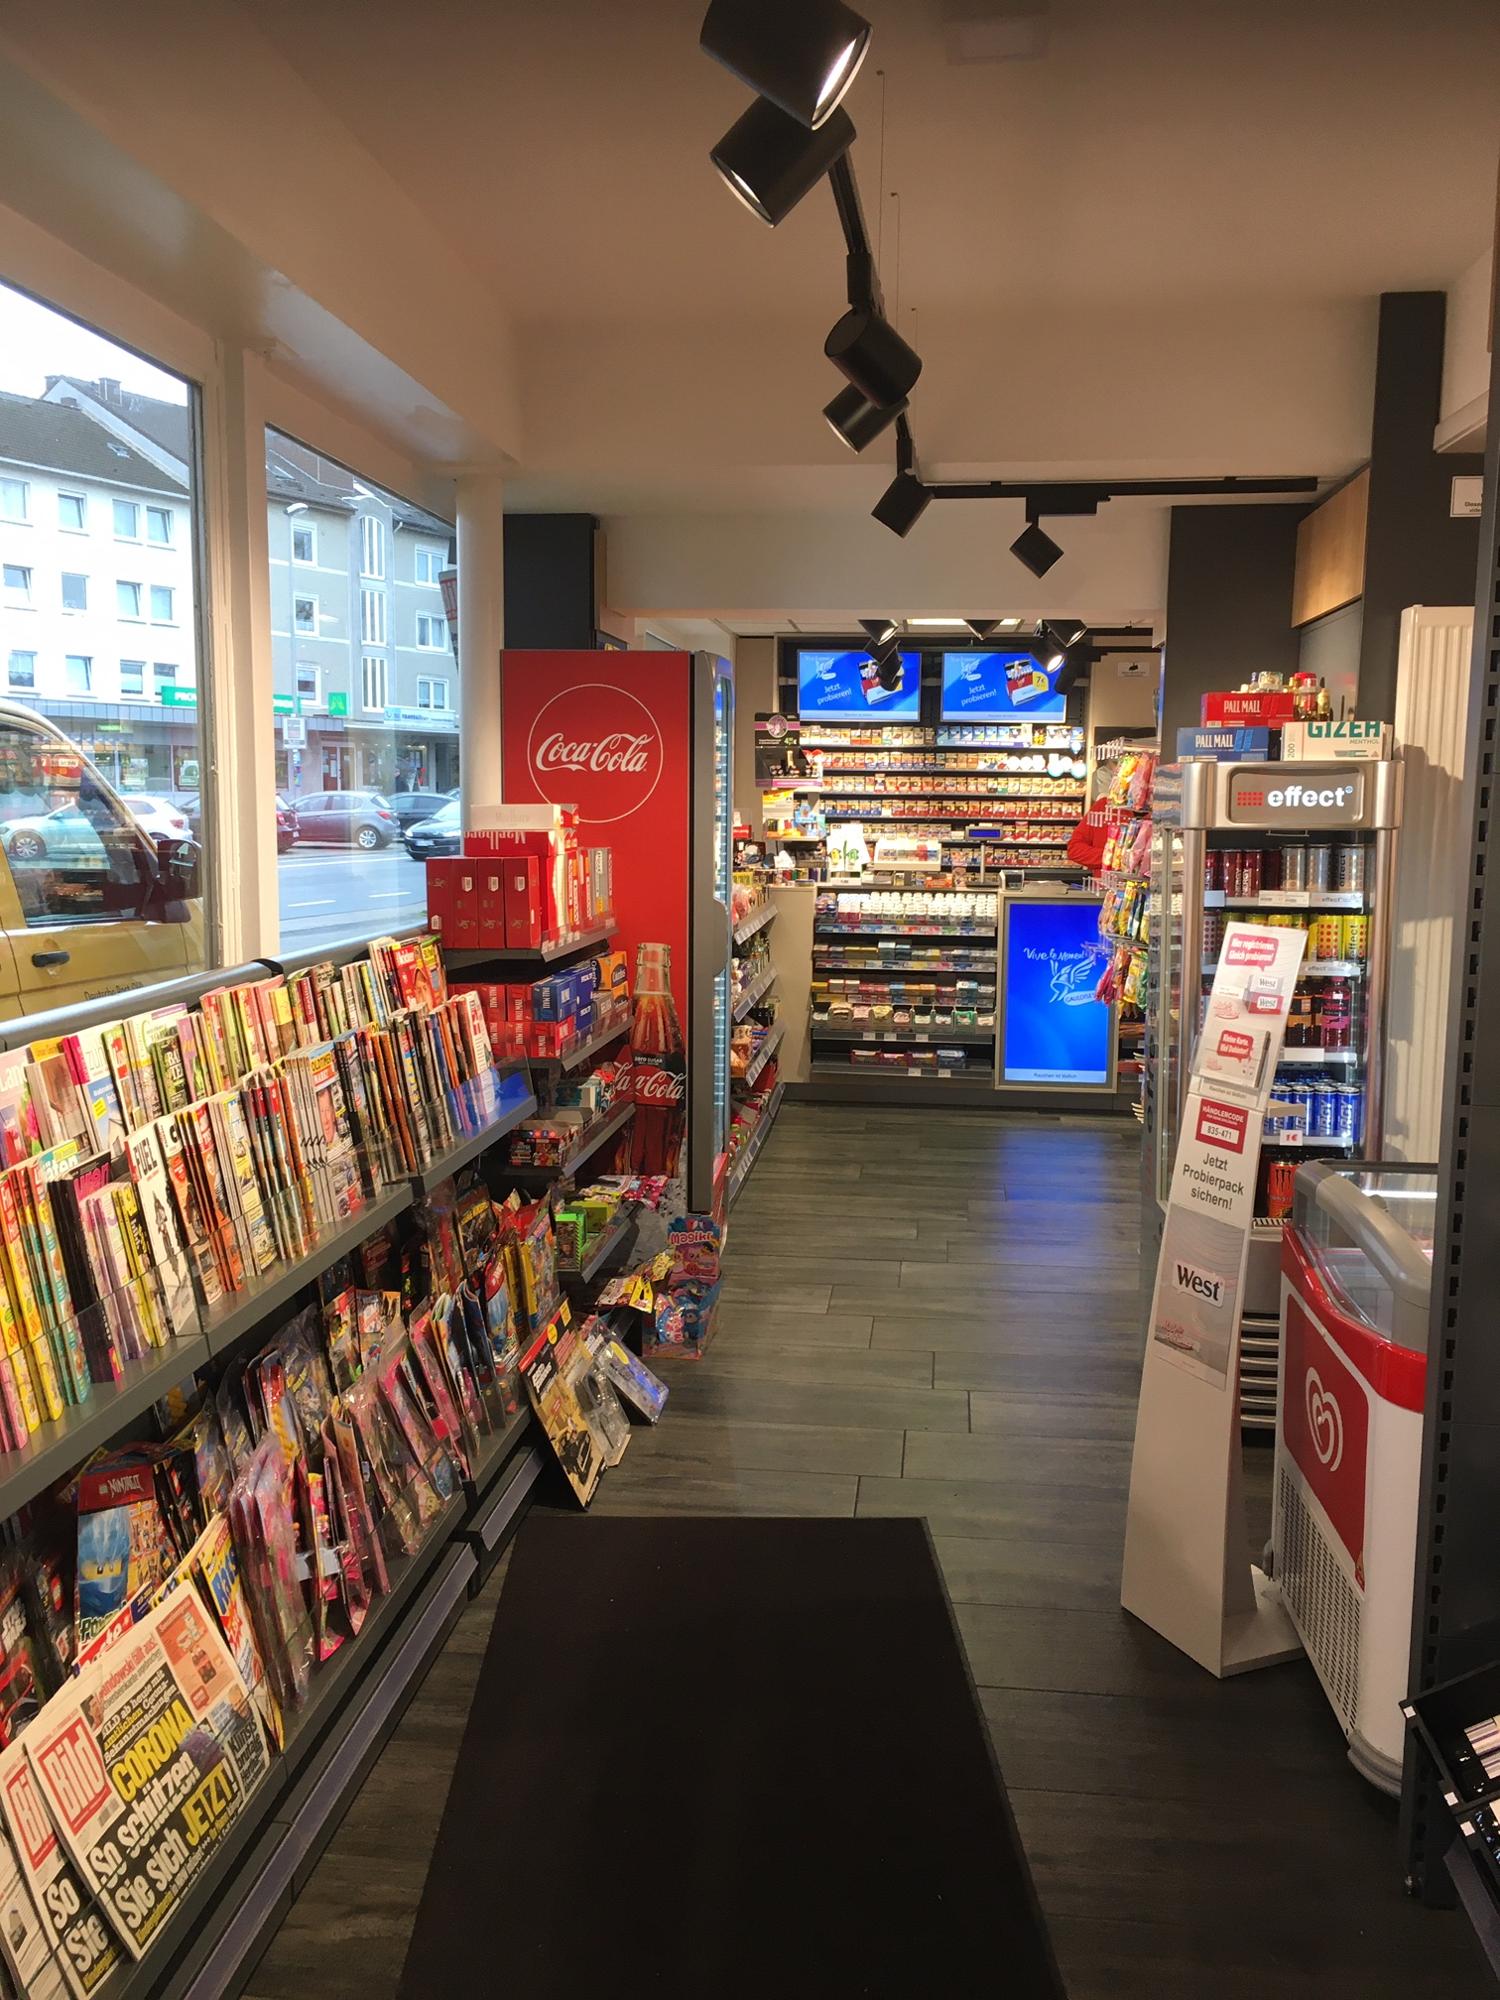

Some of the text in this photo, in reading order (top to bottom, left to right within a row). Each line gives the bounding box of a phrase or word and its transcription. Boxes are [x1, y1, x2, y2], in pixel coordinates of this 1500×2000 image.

[816, 688, 852, 706] probieren!
[824, 683, 841, 694] Jetzt
[961, 689, 997, 707] probieren!
[968, 684, 986, 695] Jetzt
[1223, 699, 1261, 714] PALL MALL
[1195, 733, 1234, 749] PALL MALL
[536, 732, 655, 773] Coca-Cola
[1267, 785, 1346, 808] effect
[1259, 978, 1277, 988] West
[1258, 998, 1277, 1008] West
[1202, 1105, 1245, 1123] HÄNDLERCODE
[1203, 1153, 1228, 1171] Jetzt
[1183, 1164, 1245, 1196] Probierpack
[1191, 1186, 1233, 1210] sichern!
[1177, 1264, 1220, 1301] West
[112, 1699, 194, 1803] CORONA
[90, 1842, 127, 1889] So
[117, 1751, 200, 1859] schützen
[115, 1875, 155, 1928] Sie
[146, 1827, 189, 1891] sich
[181, 1757, 239, 1846] JETZT!
[47, 1877, 80, 1930] So
[65, 1914, 108, 1973] Sie
